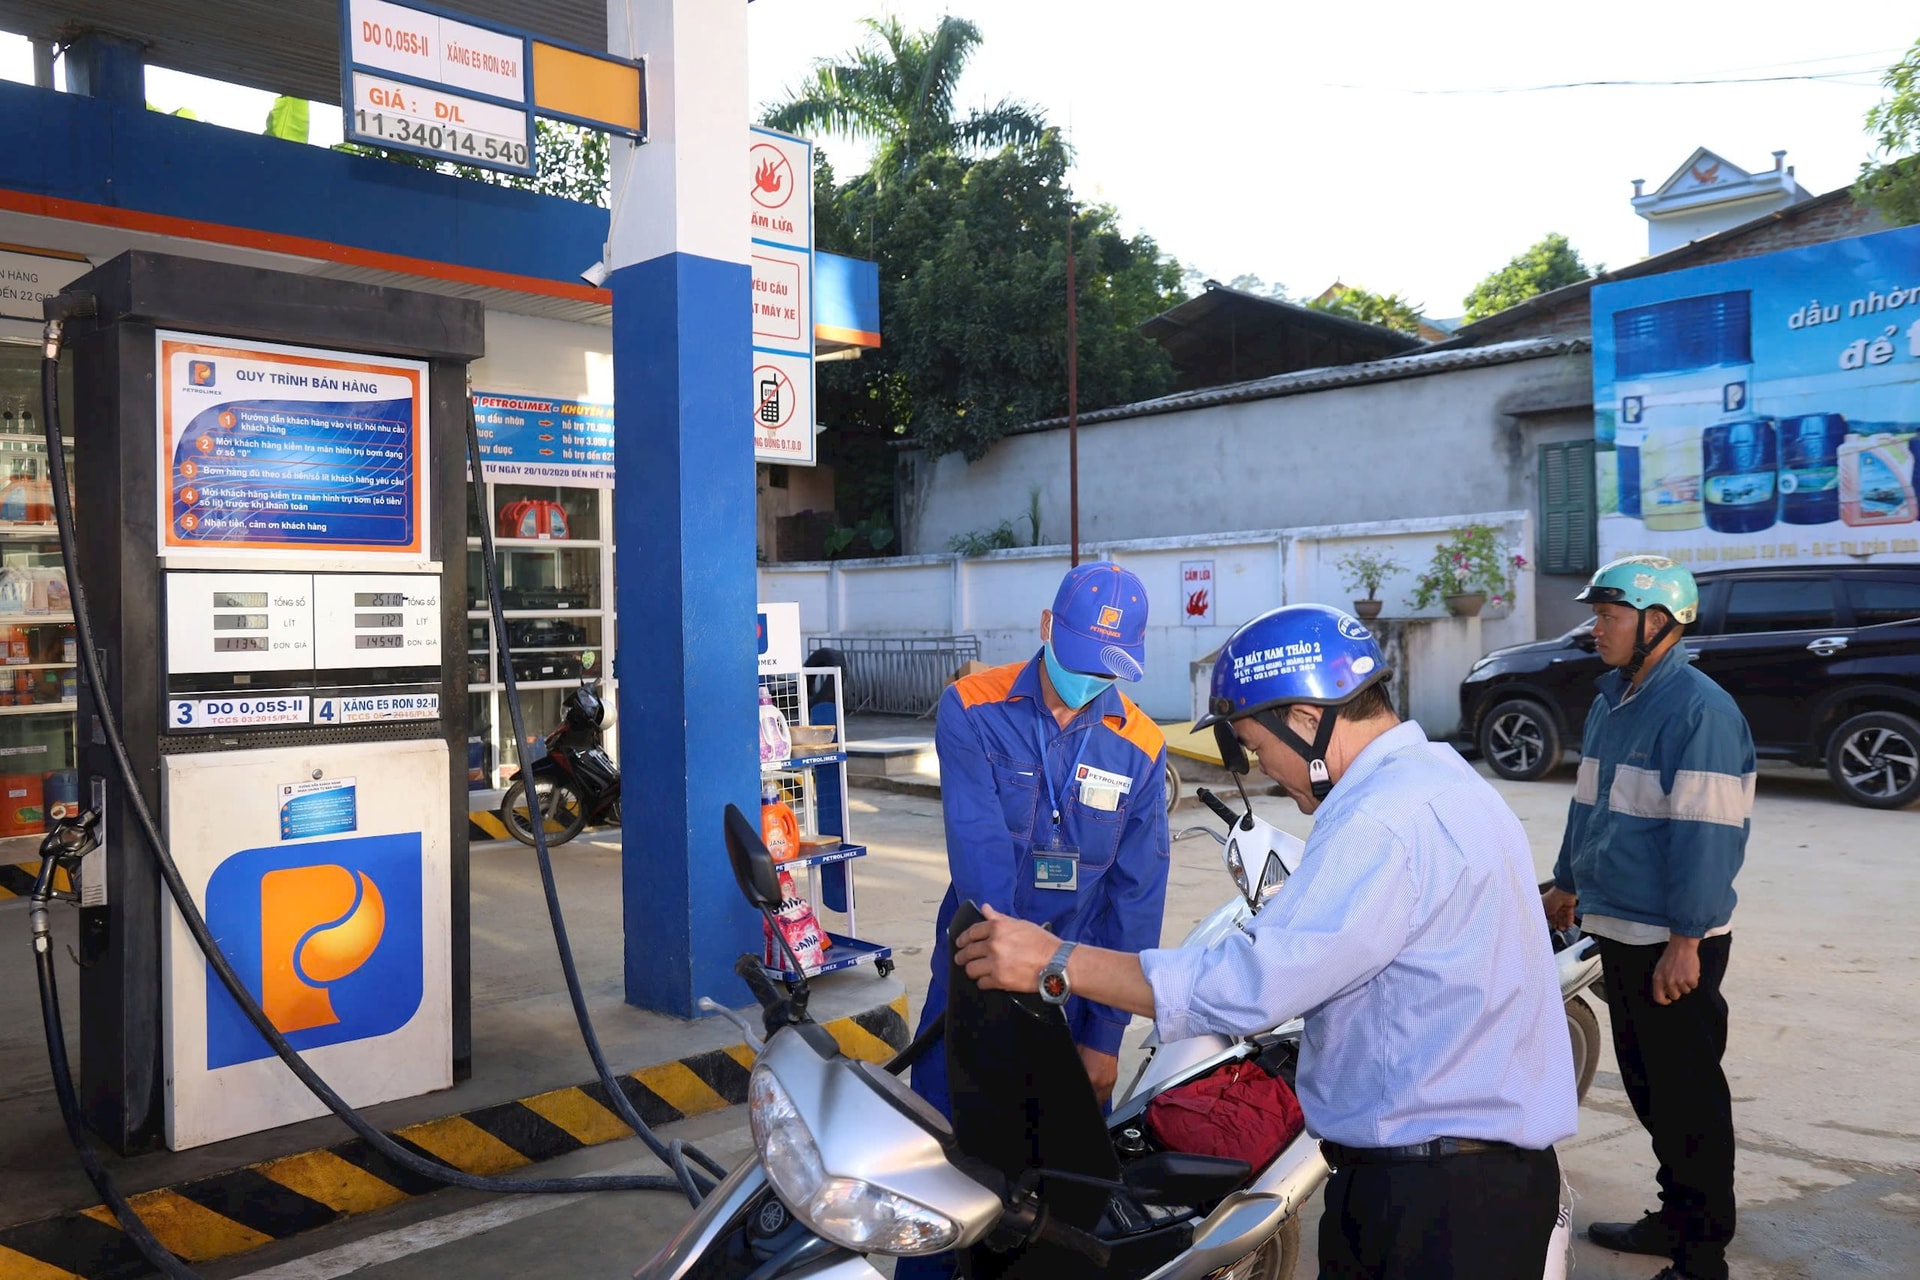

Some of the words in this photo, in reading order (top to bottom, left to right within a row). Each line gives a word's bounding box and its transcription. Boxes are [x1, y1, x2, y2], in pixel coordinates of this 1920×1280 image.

[363, 21, 382, 45] DO
[385, 28, 428, 57] 0,05S-II
[472, 51, 481, 69] E5
[483, 54, 499, 73] RON
[501, 59, 516, 78] 92-II
[369, 88, 405, 110] GIÁ
[435, 102, 464, 123] Đ/L
[356, 109, 442, 149] 11.340
[447, 130, 527, 165] 14.540
[751, 211, 768, 228] ẤM
[20, 290, 32, 301] 22
[762, 304, 781, 318] MÁY
[784, 308, 795, 320] XE
[1788, 299, 1840, 330] dầu
[1839, 324, 1898, 370] để
[236, 370, 265, 382] QUY
[269, 372, 308, 387] TRÌNH
[312, 376, 338, 390] BÁN
[342, 380, 378, 394] HÀNG
[482, 398, 552, 412] PETROLIMEX
[226, 416, 231, 425] 1
[287, 416, 309, 425] khách
[311, 417, 329, 428] hàng
[331, 420, 344, 429] vào
[378, 424, 391, 432] nhu
[241, 423, 265, 432] khách
[267, 424, 286, 435] hàng
[202, 440, 209, 449] 2
[216, 437, 232, 446] Mời
[235, 438, 259, 447] khách
[262, 440, 281, 450] hàng
[317, 444, 334, 453] màn
[186, 465, 192, 474] 3
[227, 467, 247, 477] hàng
[331, 473, 353, 483] khách
[356, 475, 374, 485] hàng
[524, 467, 569, 477] 20/10/2020
[186, 491, 193, 500] 4
[202, 488, 218, 496] Mời
[221, 489, 246, 498] khách
[248, 491, 268, 501] hàng
[305, 493, 321, 501] màn
[252, 500, 264, 508] khi
[266, 500, 288, 509] thanh
[187, 517, 193, 526] 5
[204, 519, 227, 528] Nhận
[282, 521, 305, 530] khách
[308, 522, 327, 532] hàng
[367, 636, 401, 647] 14540
[1234, 656, 1244, 670] XE
[1245, 650, 1263, 666] MÁY
[1264, 646, 1284, 660] NAM
[1285, 640, 1312, 656] THẢO
[1314, 642, 1320, 653] 2
[177, 702, 192, 724] 3
[207, 702, 233, 714] DO
[240, 700, 302, 715] 0,05S-II
[319, 700, 334, 720] 4
[344, 698, 374, 712] XĂNG
[377, 701, 388, 710] E5
[392, 699, 413, 709] RON
[416, 698, 436, 708] 92-II
[212, 716, 238, 724] TCCS
[822, 851, 857, 862] PETROLIMEX
[794, 934, 818, 952] JANA
